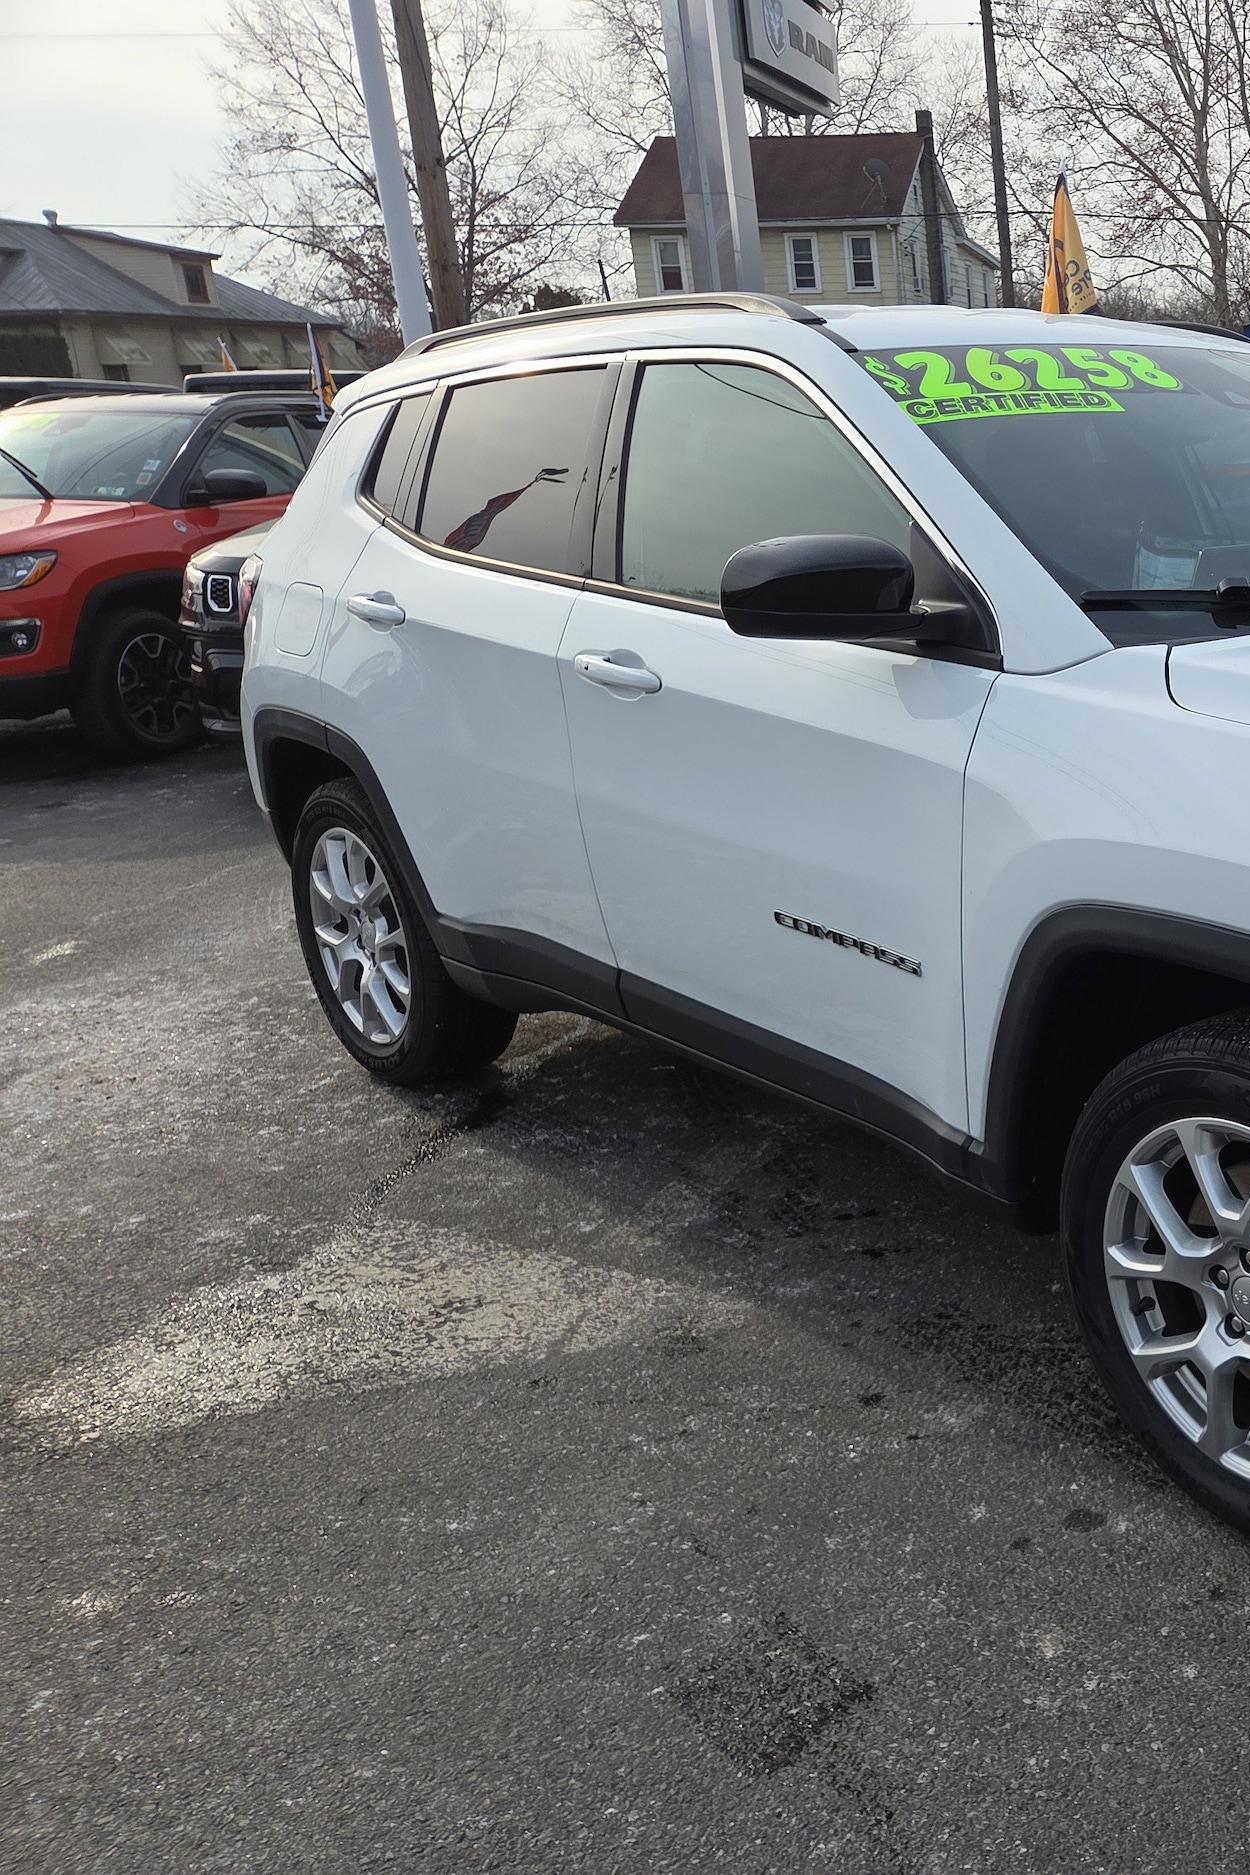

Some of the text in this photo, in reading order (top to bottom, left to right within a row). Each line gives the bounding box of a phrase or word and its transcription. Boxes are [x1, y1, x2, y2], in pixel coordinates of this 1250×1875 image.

[787, 19, 835, 75] RAM
[863, 347, 1184, 398] $26258
[905, 392, 1112, 419] CERTIFIED
[773, 907, 922, 978] COMPASS
